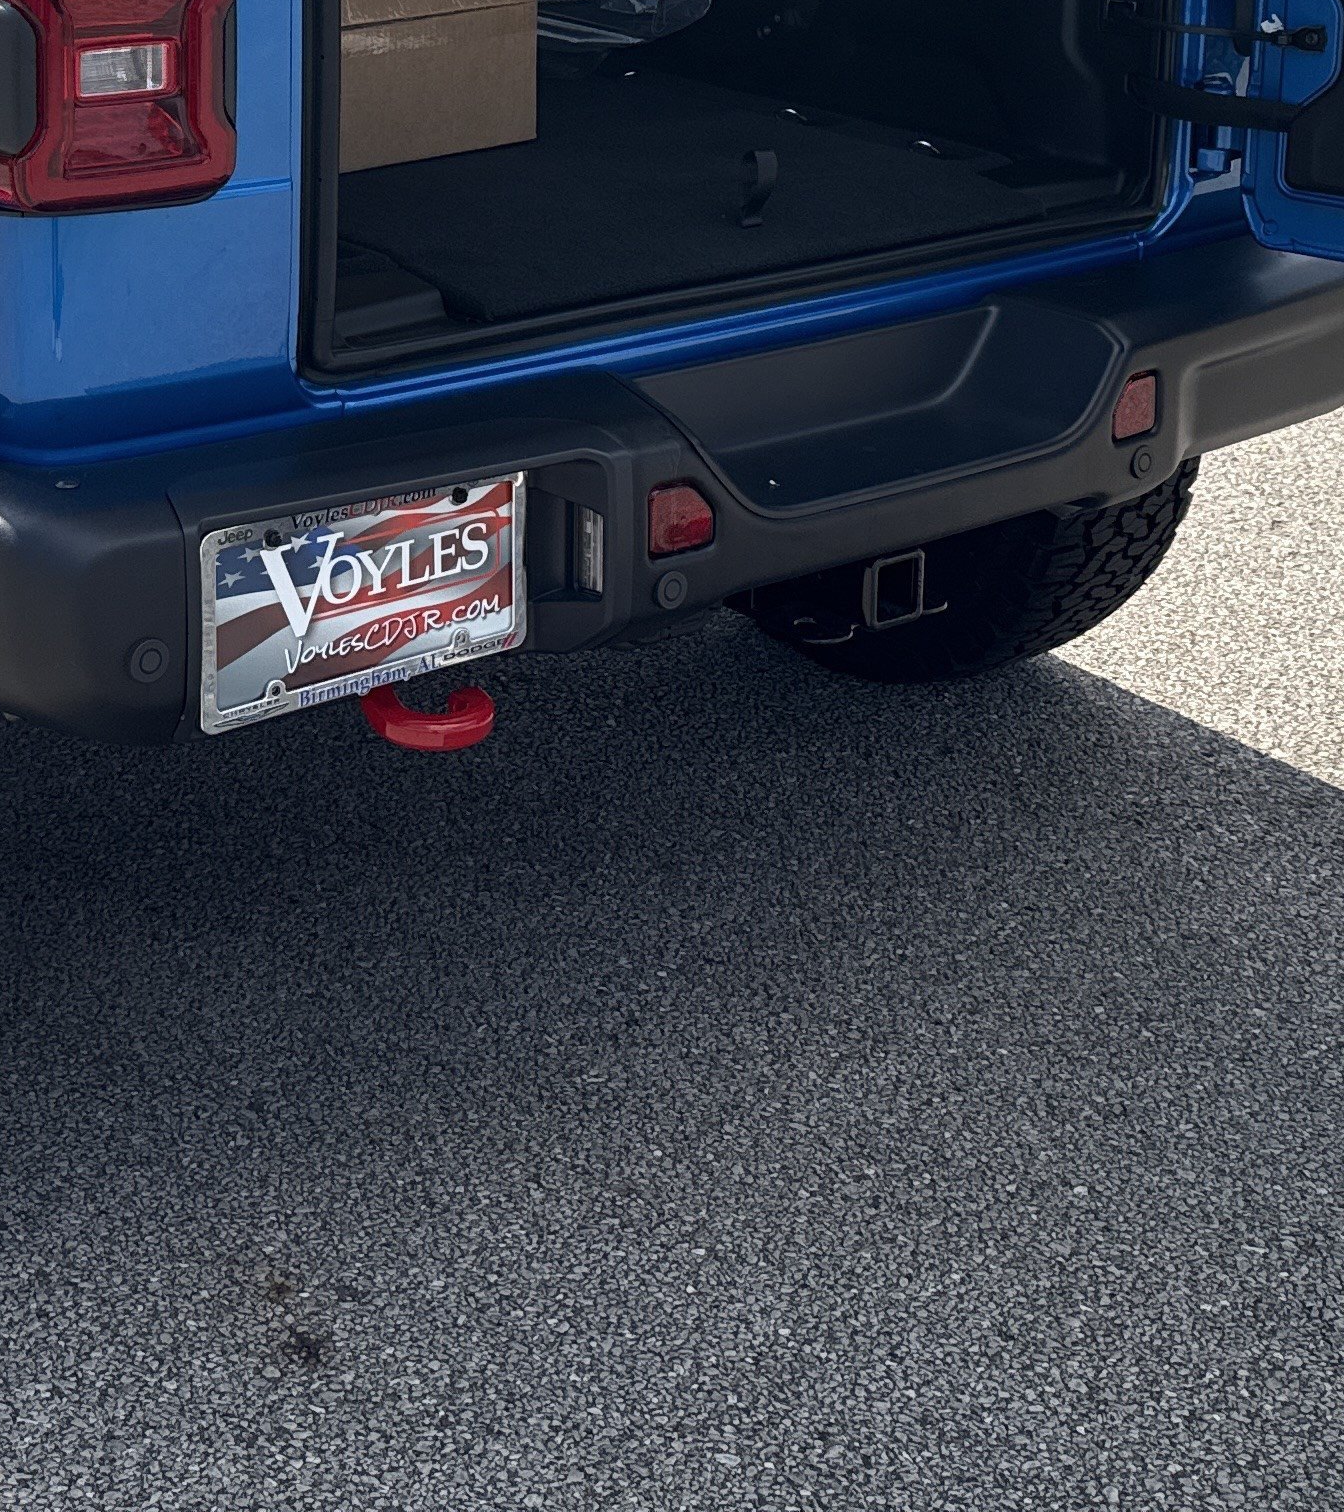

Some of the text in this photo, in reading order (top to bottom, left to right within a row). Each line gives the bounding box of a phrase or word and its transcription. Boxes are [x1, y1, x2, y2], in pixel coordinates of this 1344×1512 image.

[218, 529, 253, 545] Jeep
[443, 638, 504, 661] DODGE
[222, 698, 280, 719] CHRYSLER
